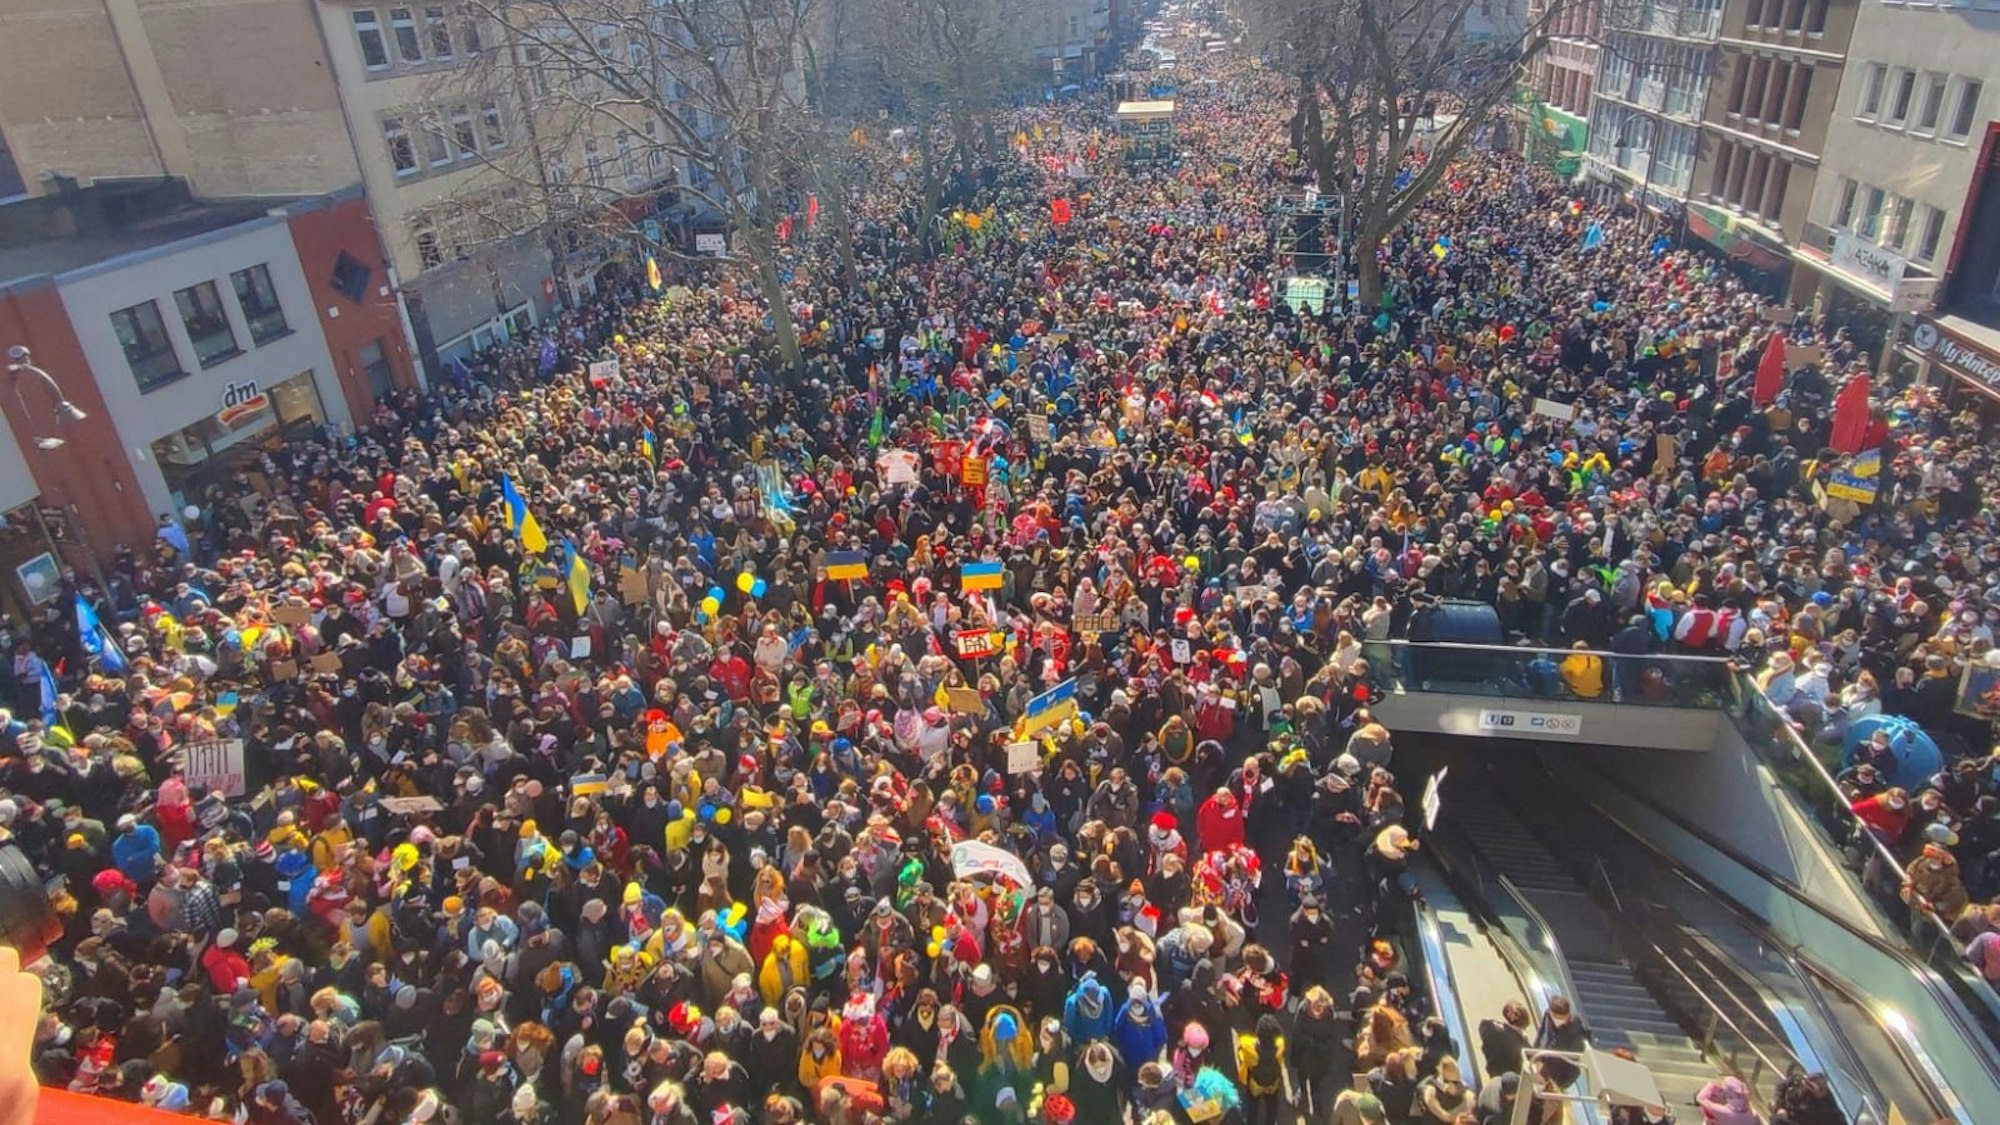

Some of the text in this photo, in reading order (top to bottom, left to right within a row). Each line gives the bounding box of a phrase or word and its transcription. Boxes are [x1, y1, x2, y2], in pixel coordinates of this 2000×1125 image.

[1936, 338, 1961, 362] My
[225, 382, 257, 408] dm
[1075, 615, 1118, 630] PEACE
